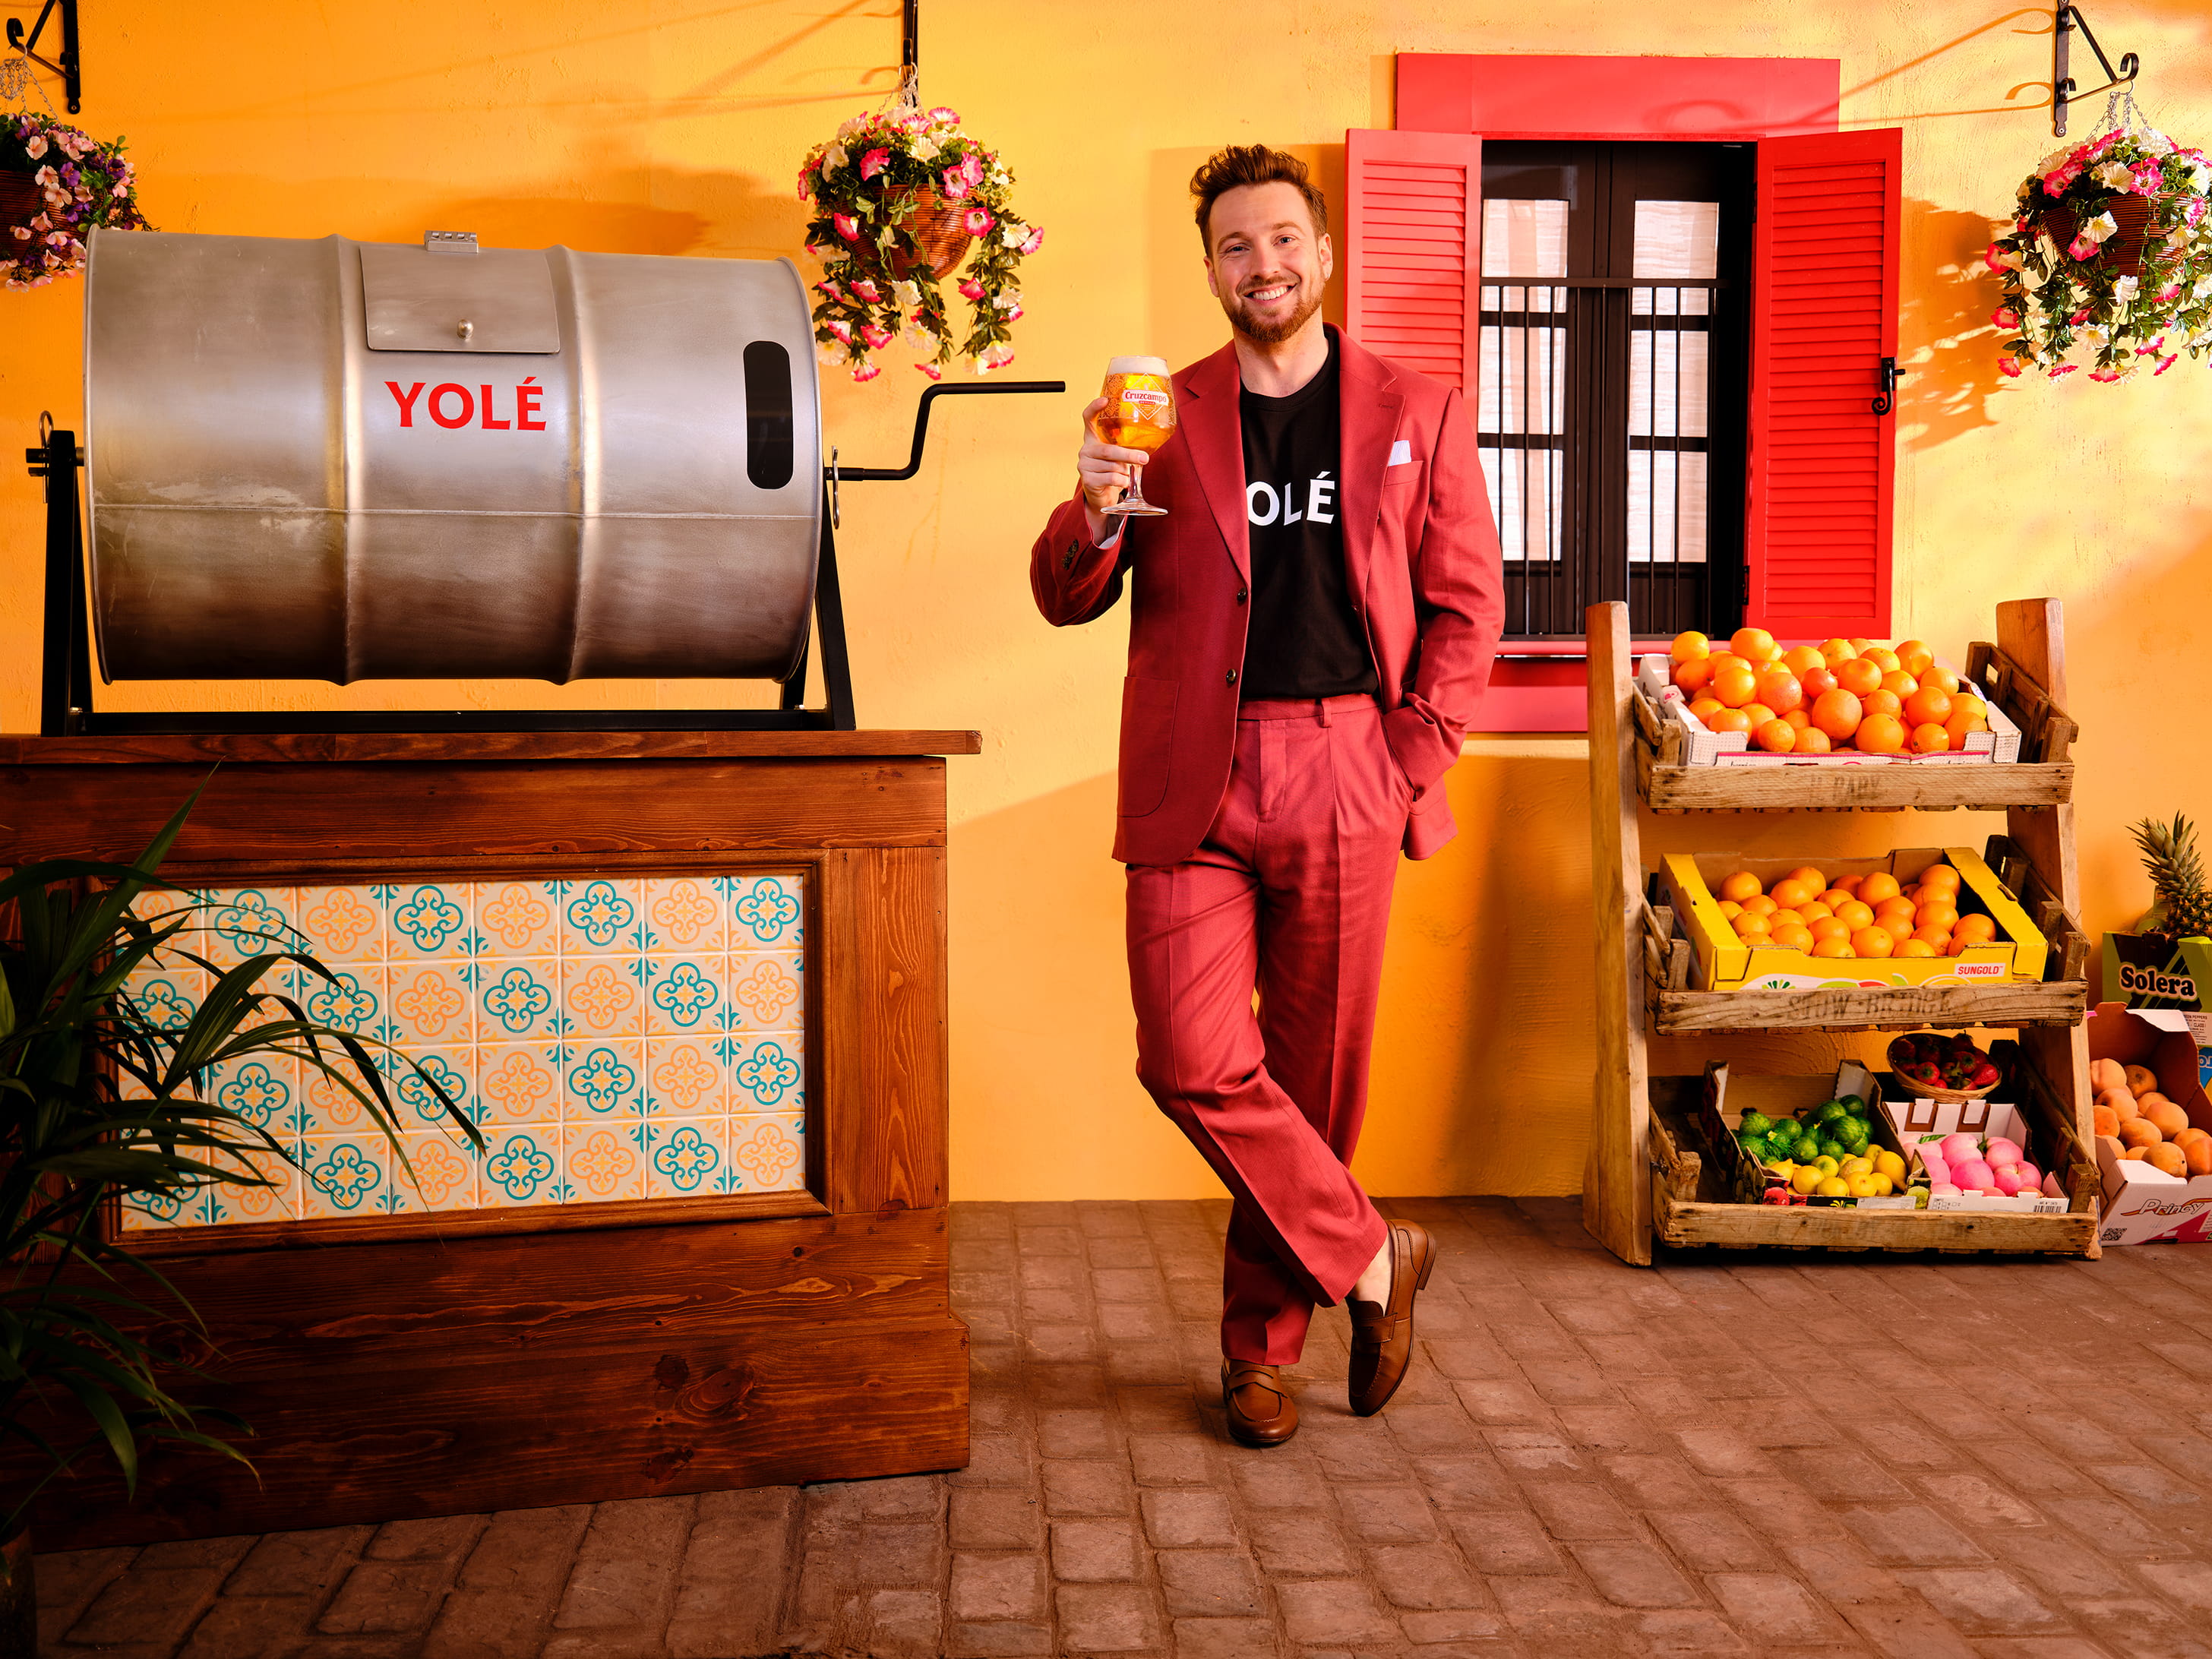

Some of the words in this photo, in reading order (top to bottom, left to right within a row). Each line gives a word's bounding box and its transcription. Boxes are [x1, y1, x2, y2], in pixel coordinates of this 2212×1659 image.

[384, 377, 546, 431] YOLÉ
[1125, 391, 1167, 403] Cruzcampo
[1958, 965, 1999, 975] SUNGOLD
[2121, 966, 2195, 997] Solera
